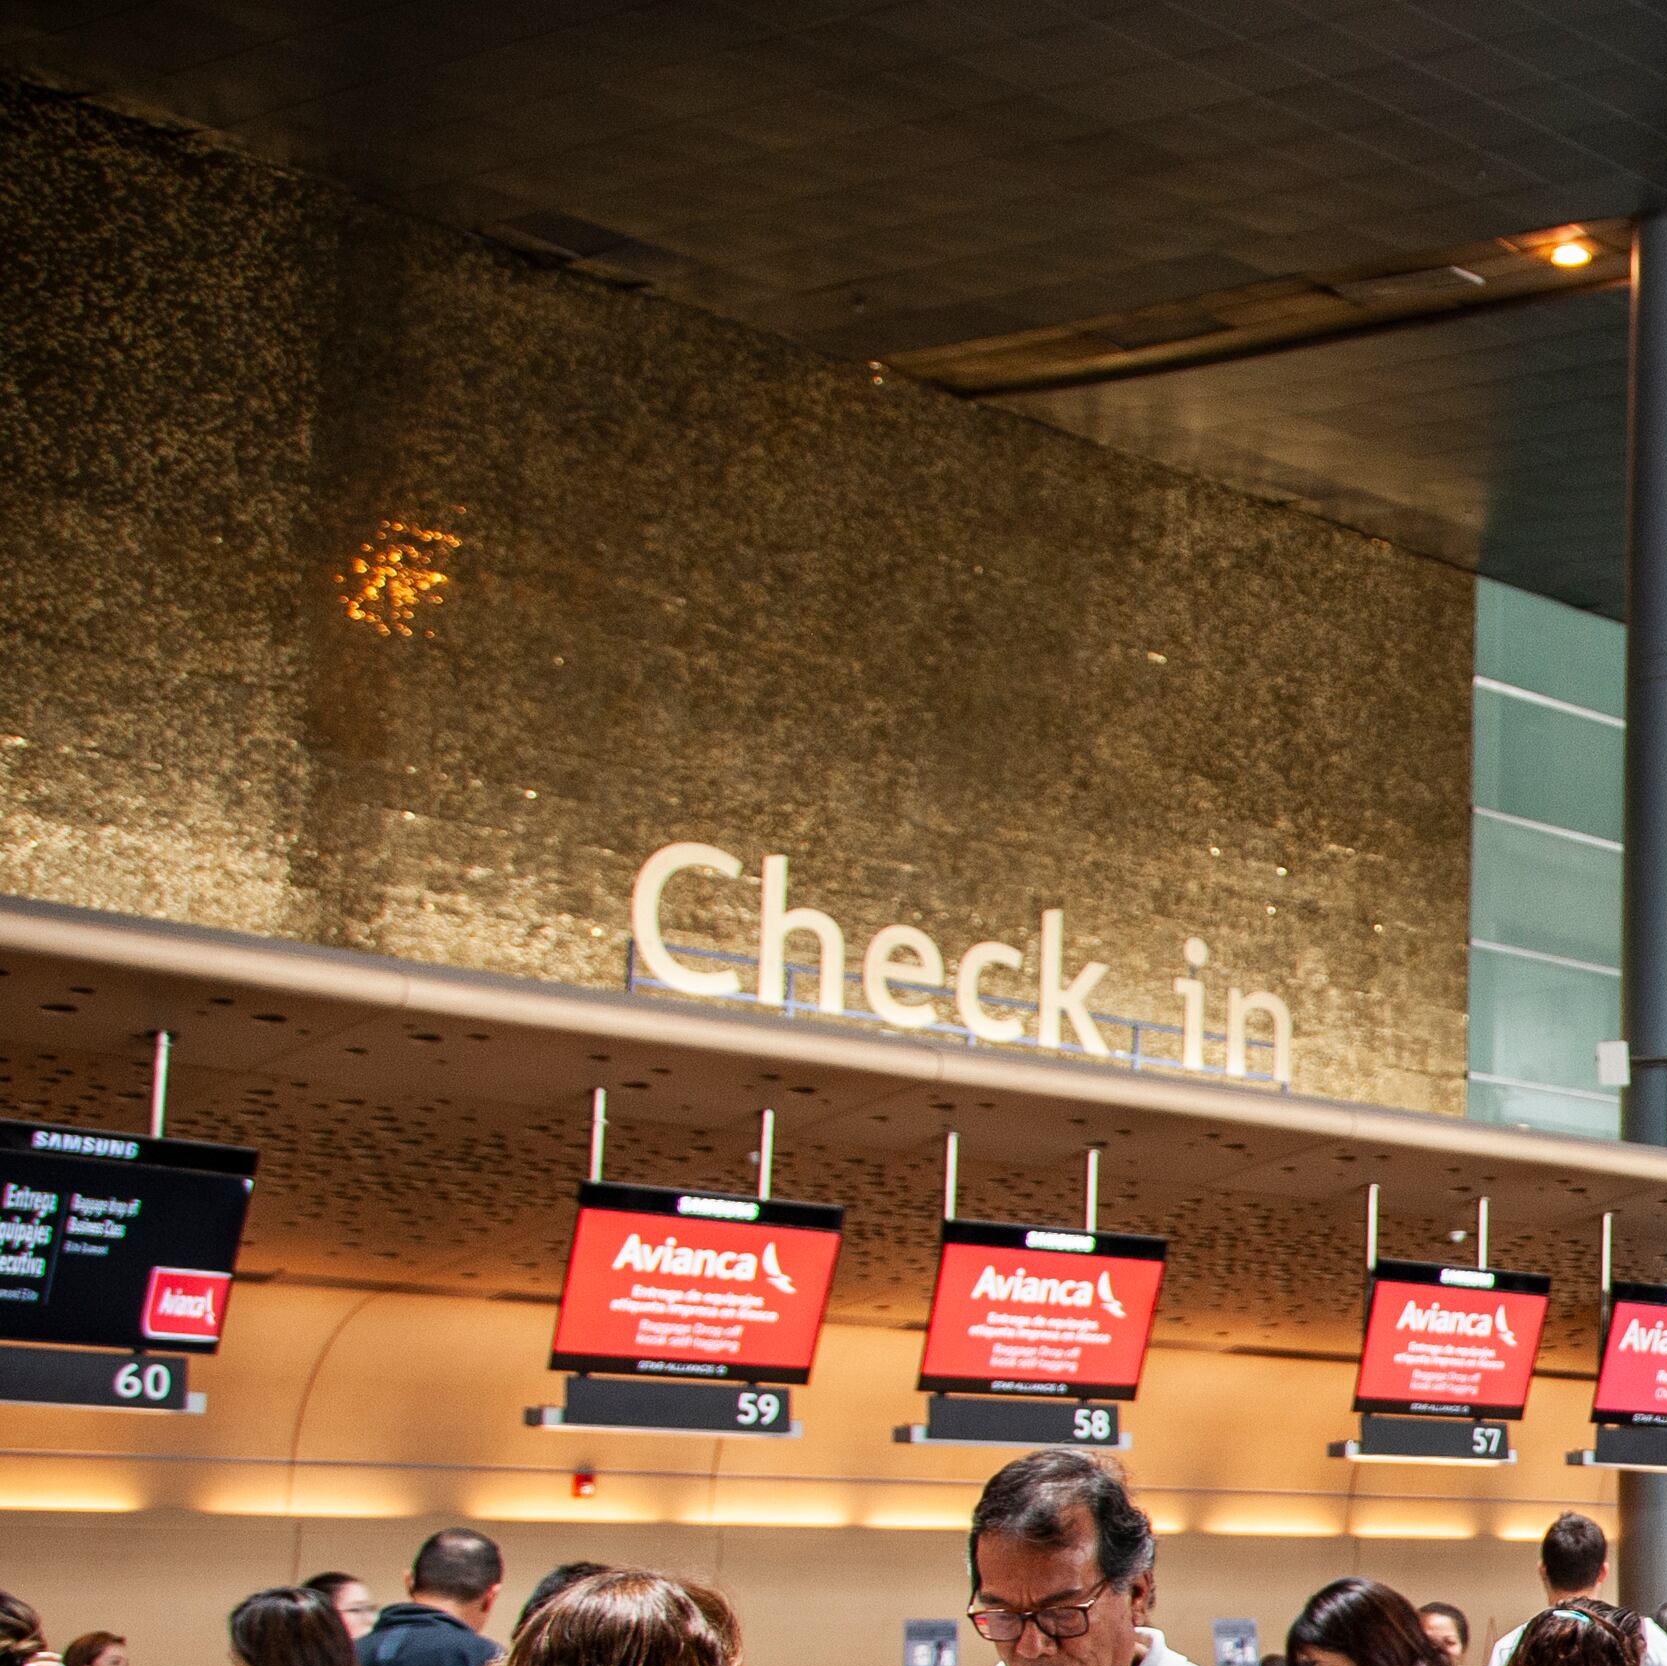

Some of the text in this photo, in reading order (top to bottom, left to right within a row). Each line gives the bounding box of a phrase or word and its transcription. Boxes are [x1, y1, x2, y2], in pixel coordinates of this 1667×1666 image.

[630, 841, 1292, 1085] Check in
[31, 1130, 140, 1159] SAMSUNG
[612, 1233, 758, 1281] Avianca
[157, 1286, 206, 1319] Avianca
[970, 1265, 1094, 1307] Avianca
[1396, 1300, 1493, 1338] Avianca
[112, 1362, 172, 1401] 60
[736, 1392, 781, 1426] 59
[1073, 1408, 1111, 1439] 58
[1472, 1427, 1501, 1455] 57
